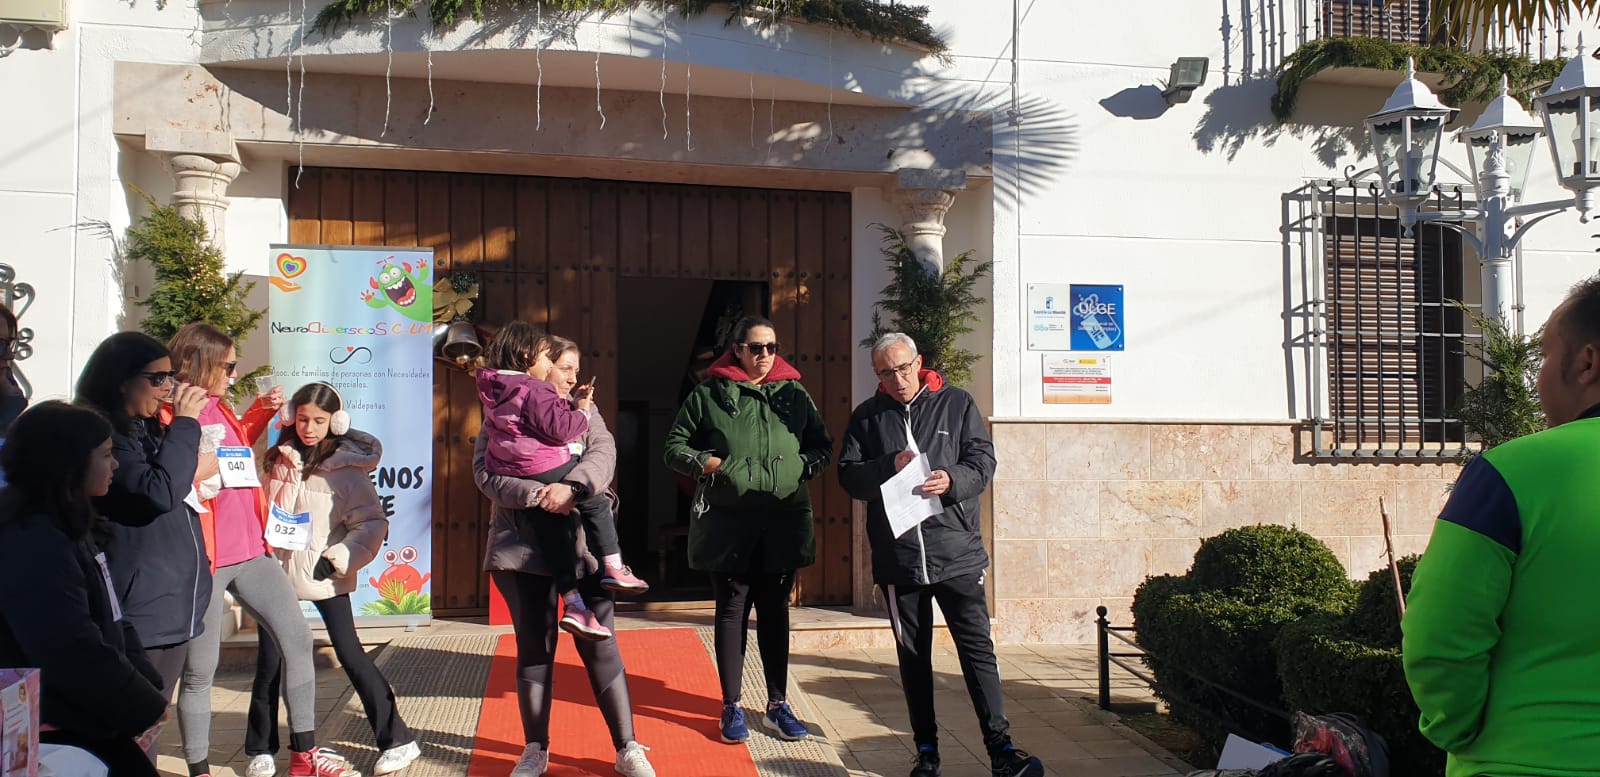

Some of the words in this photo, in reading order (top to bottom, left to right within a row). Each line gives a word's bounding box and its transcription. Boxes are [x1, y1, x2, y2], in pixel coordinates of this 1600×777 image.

[291, 368, 300, 377] de
[301, 366, 329, 377] familias
[331, 367, 340, 378] de
[341, 370, 372, 380] personas
[387, 368, 430, 379] Necesidades
[346, 399, 386, 411] Valdepeñas
[228, 461, 245, 471] 040
[274, 524, 296, 535] 032
